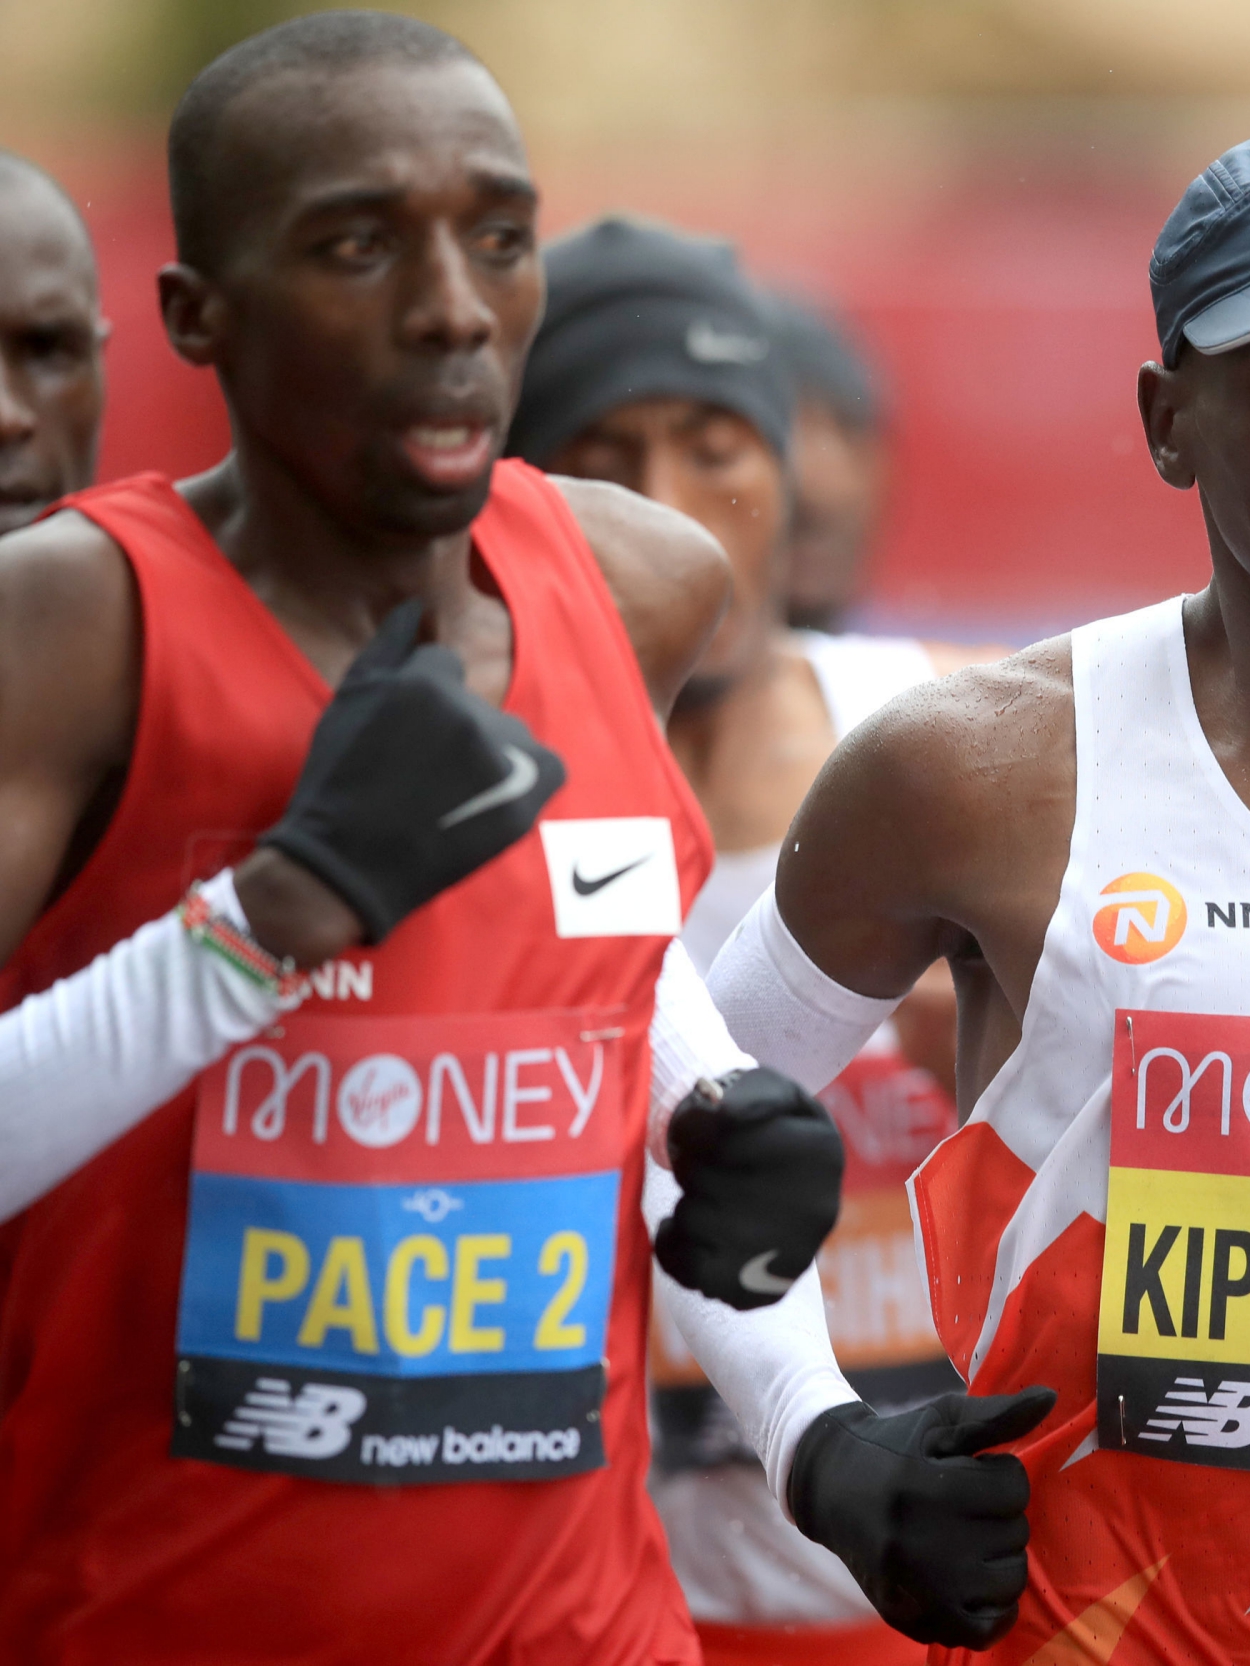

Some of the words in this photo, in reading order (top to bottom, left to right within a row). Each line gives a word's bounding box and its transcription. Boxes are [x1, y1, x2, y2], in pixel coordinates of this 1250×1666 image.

[234, 1226, 512, 1358] PACE
[533, 1231, 589, 1350] 2
[360, 1433, 440, 1467] new
[442, 1425, 580, 1465] balance
